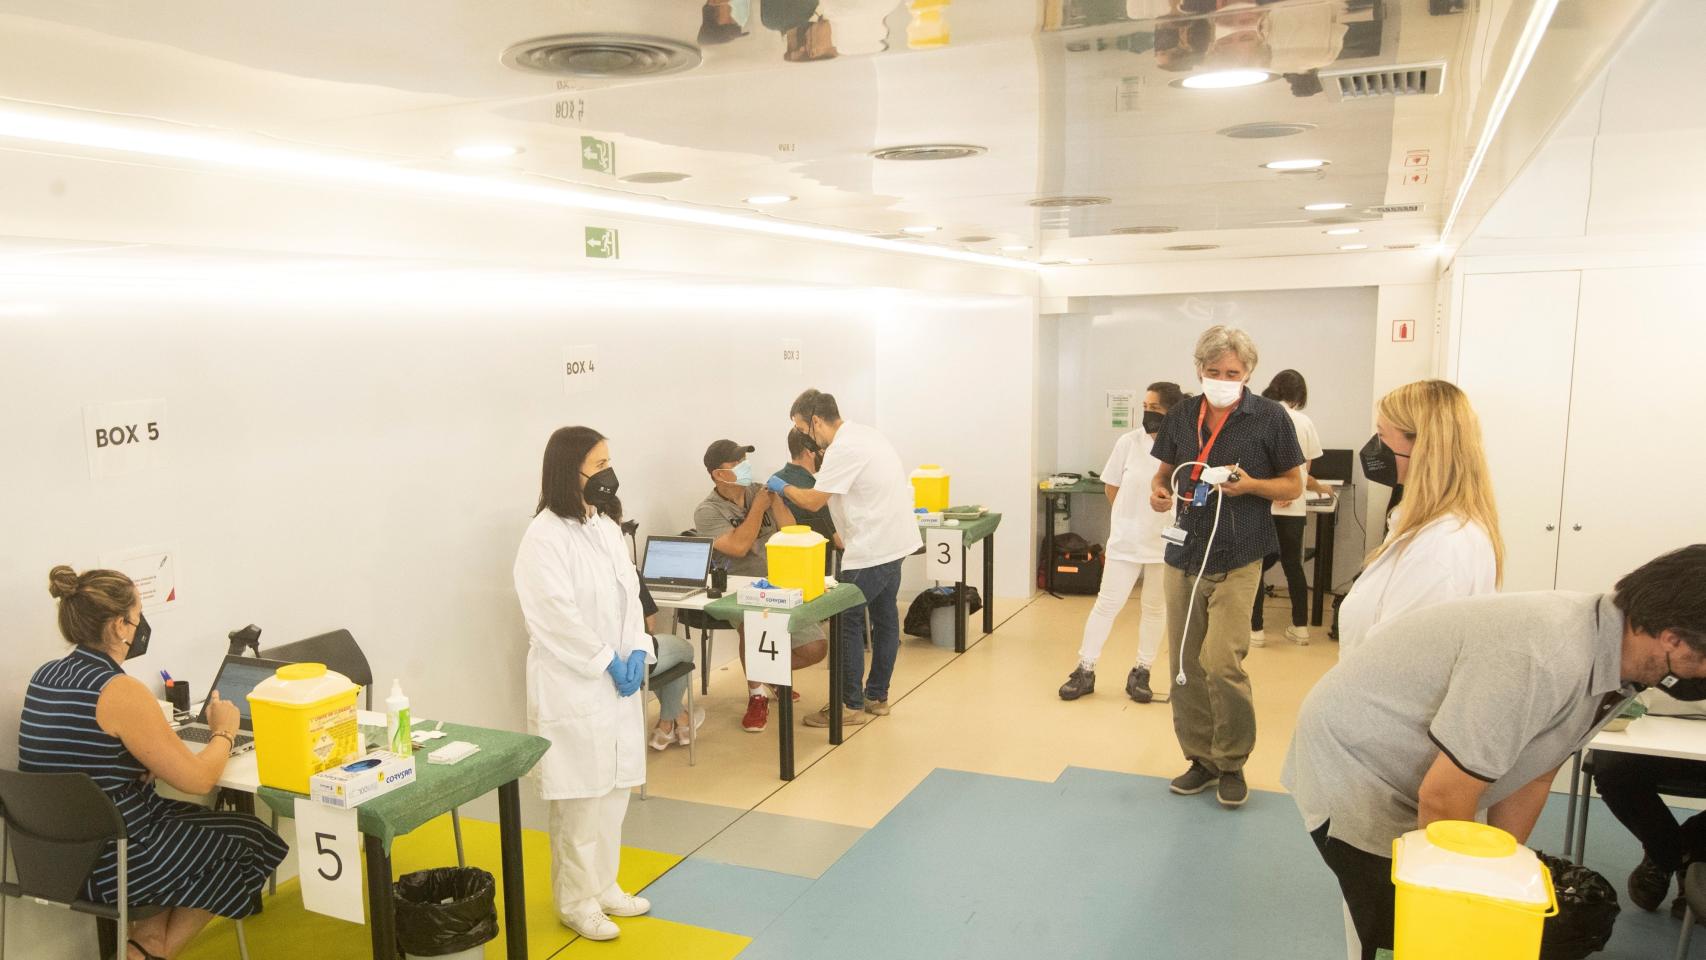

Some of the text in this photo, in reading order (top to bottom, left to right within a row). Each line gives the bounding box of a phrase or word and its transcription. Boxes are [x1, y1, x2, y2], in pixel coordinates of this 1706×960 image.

[783, 350, 800, 361] BOX 3
[566, 360, 595, 376] BOX 4
[95, 422, 160, 448] BOX 5
[936, 542, 951, 565] 3
[758, 630, 779, 661] 4
[314, 831, 343, 882] 5
